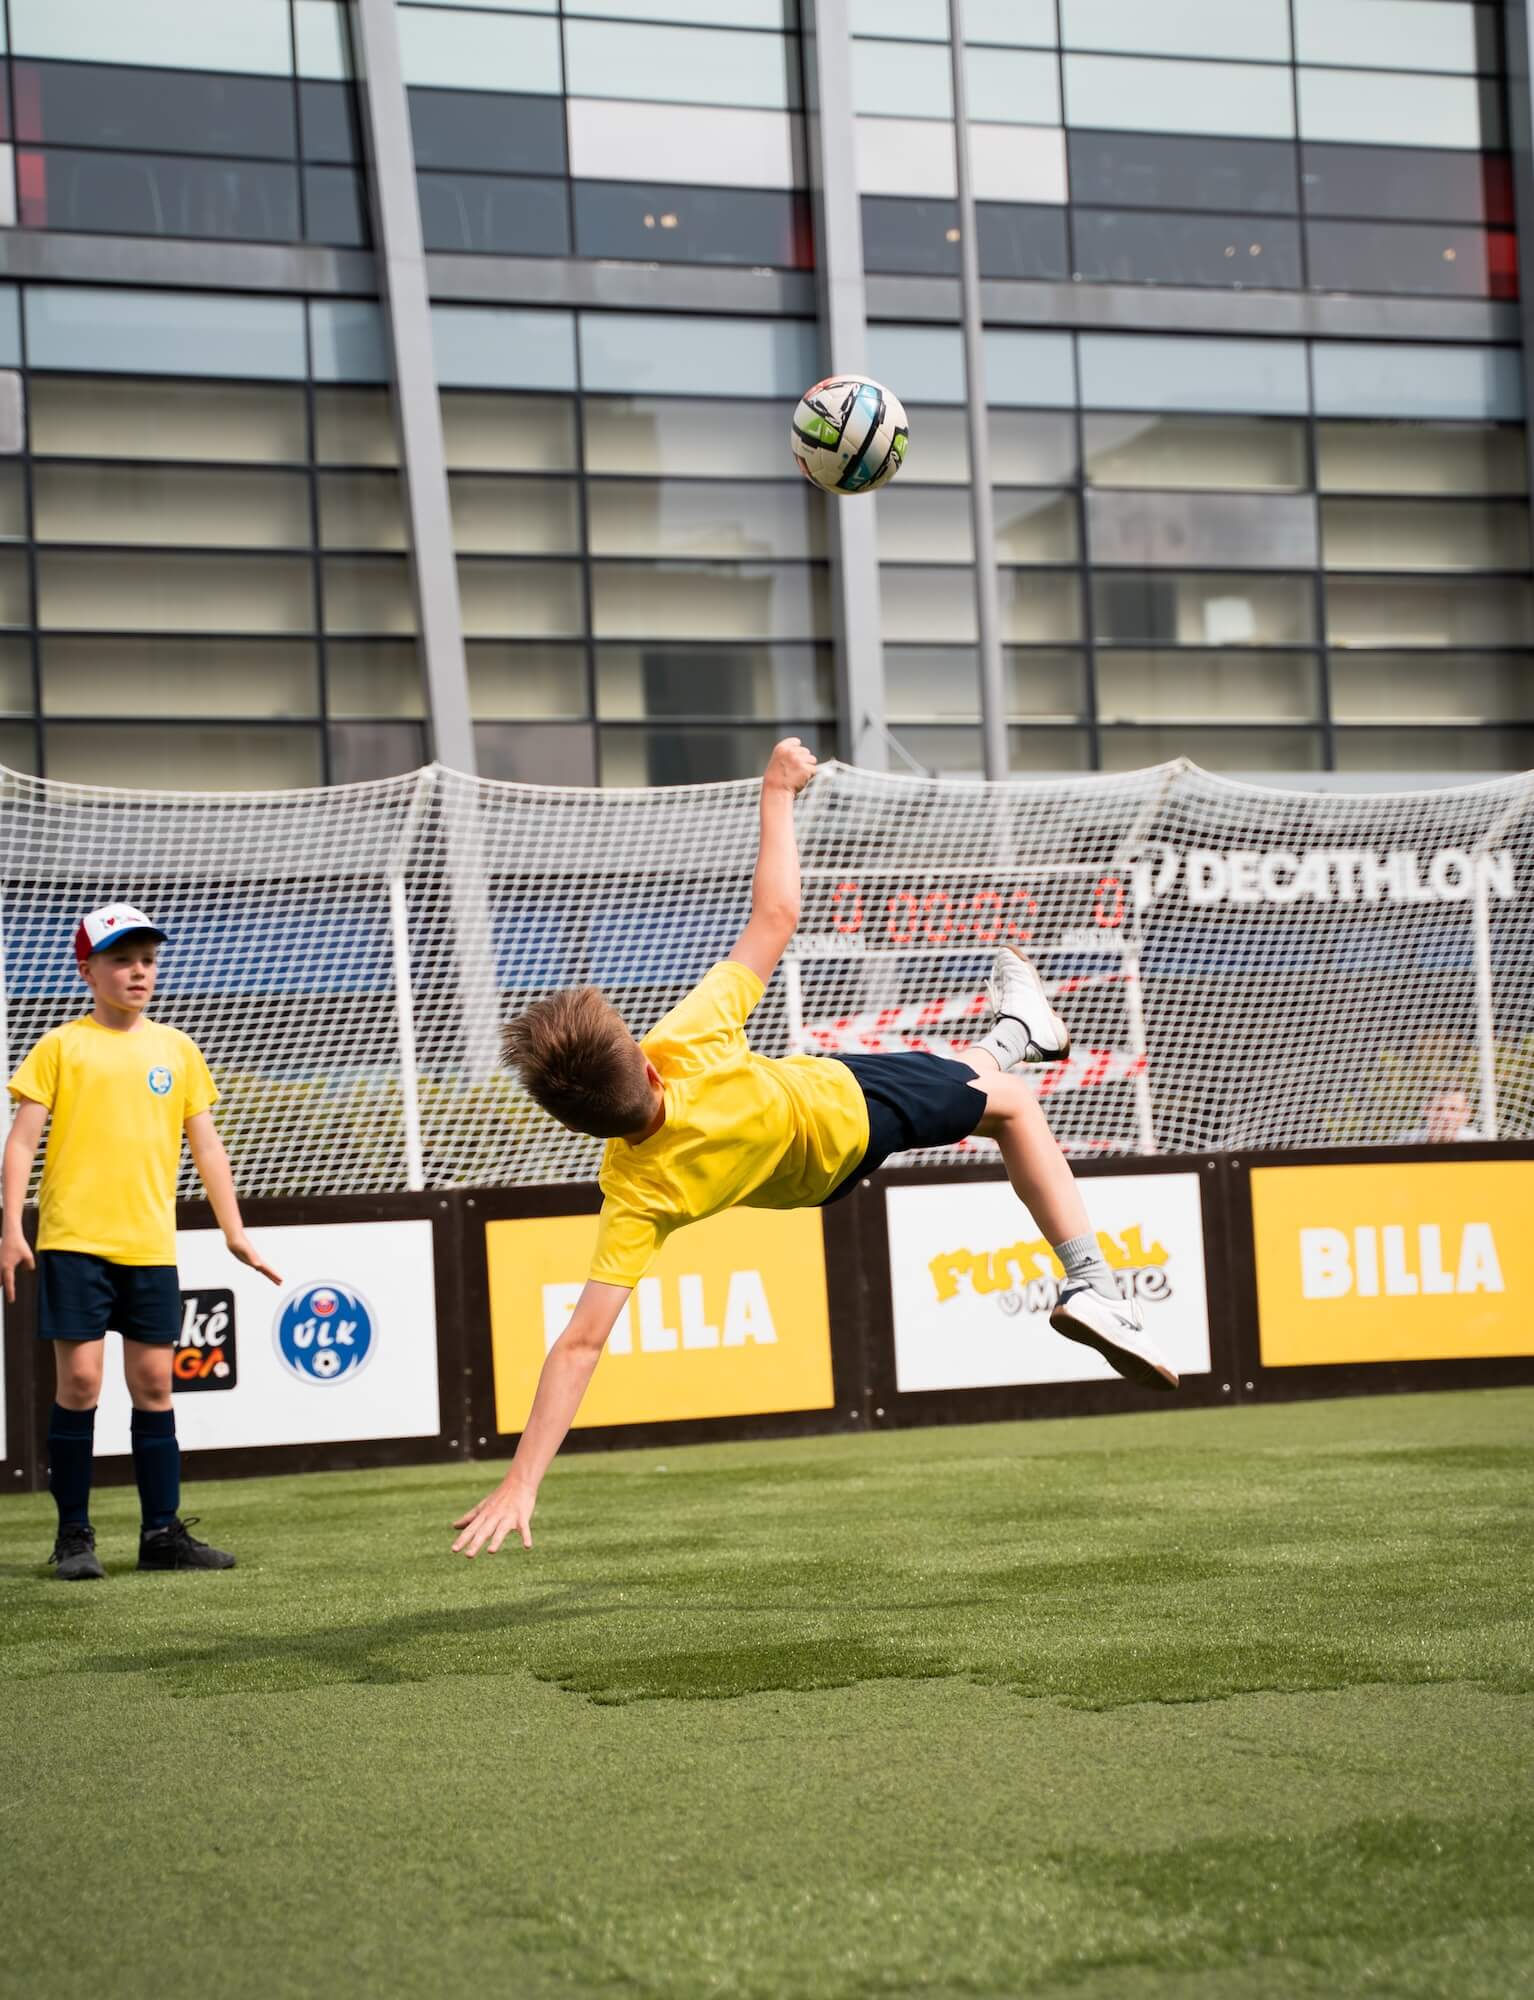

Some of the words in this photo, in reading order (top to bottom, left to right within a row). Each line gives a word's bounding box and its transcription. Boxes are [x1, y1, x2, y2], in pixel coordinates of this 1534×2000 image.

[1185, 849, 1515, 902] DECATHLON
[1094, 877, 1124, 928] 0
[928, 1223, 1169, 1303] FUTAL
[1299, 1222, 1505, 1299] BILLA
[293, 1315, 358, 1349] ÚLK
